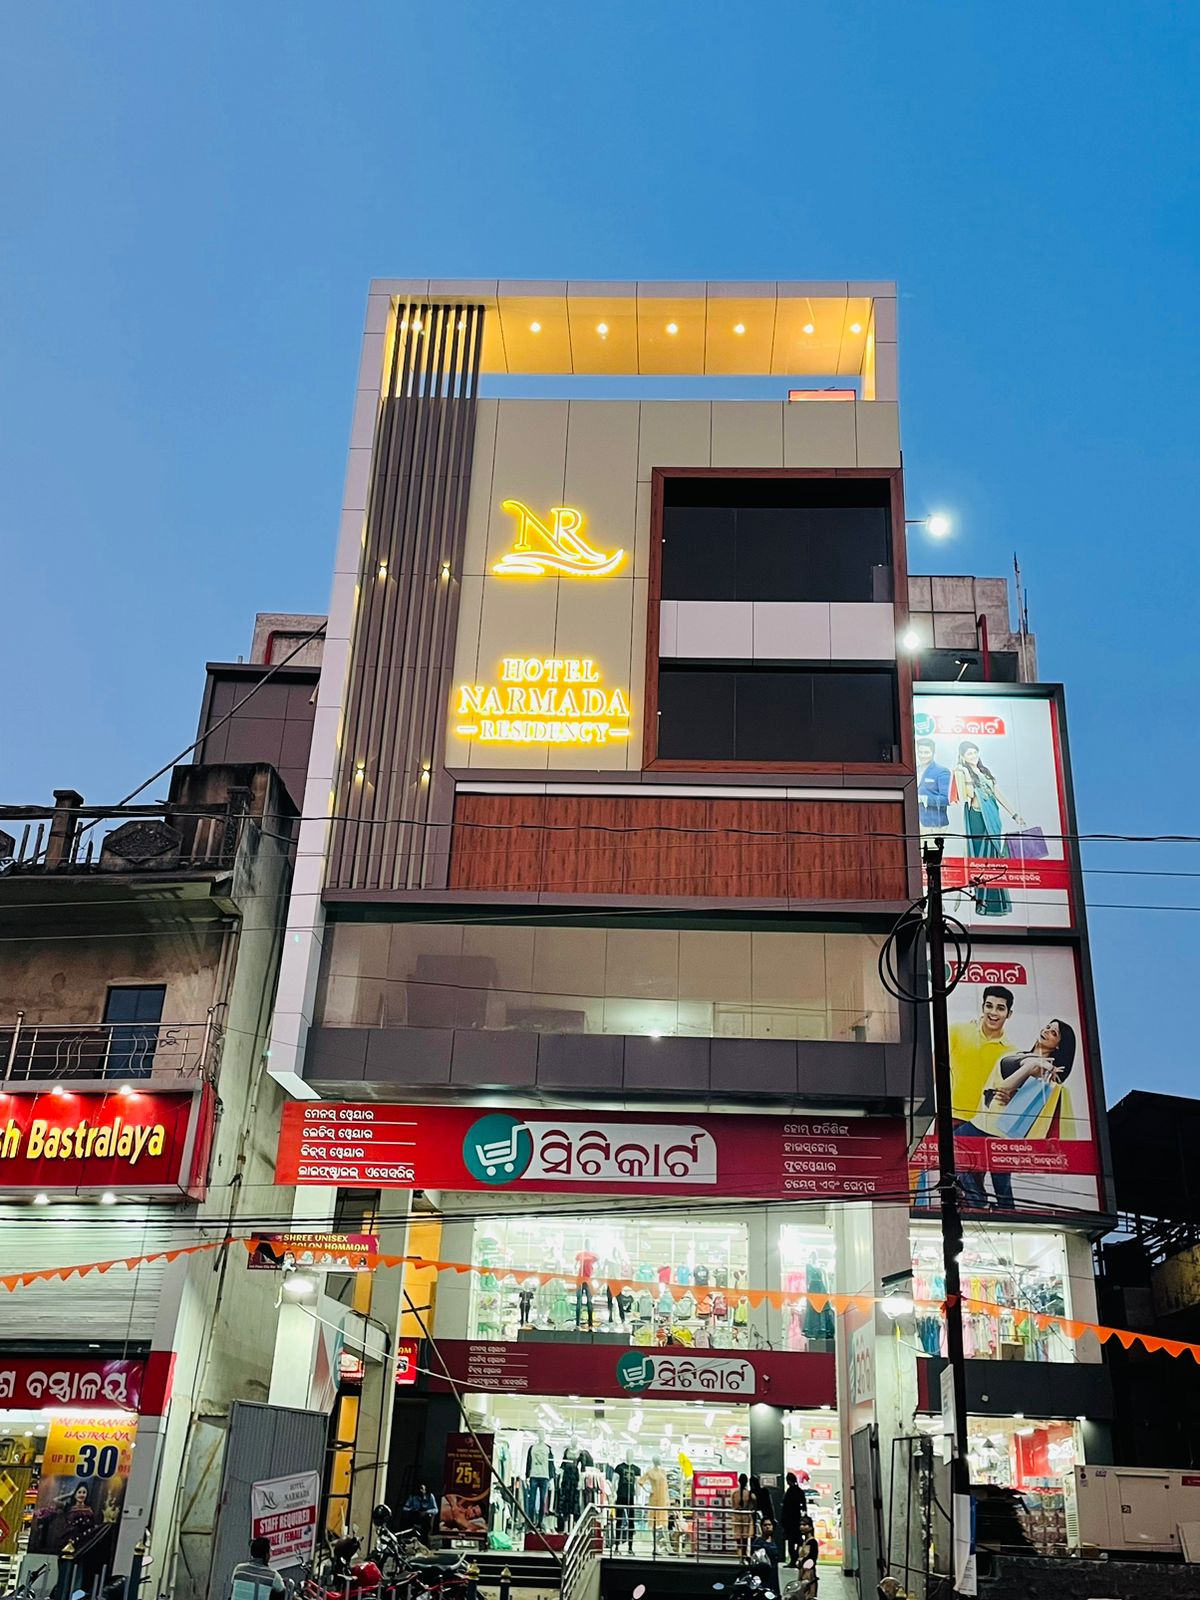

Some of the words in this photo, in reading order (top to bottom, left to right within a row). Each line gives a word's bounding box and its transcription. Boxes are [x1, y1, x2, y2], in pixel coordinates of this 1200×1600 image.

[502, 658, 599, 682] HOTEL
[458, 686, 630, 717] NARMADA
[480, 720, 610, 742] RESIDENCY
[0, 1119, 21, 1158] h
[26, 1117, 165, 1165] Bastralaya
[540, 1129, 706, 1177] ସିଟିକାର୍ଟ
[284, 1234, 313, 1242] SHREE
[315, 1234, 349, 1242] UNISEX
[325, 1243, 369, 1252] HAMMAM
[658, 1360, 749, 1390] ସିଟିକାର୍ଟ
[64, 1430, 131, 1441] BASTRALAYA
[75, 1444, 119, 1478] 30
[260, 1516, 279, 1534] STAFF
[279, 1508, 311, 1528] REQUIRED
